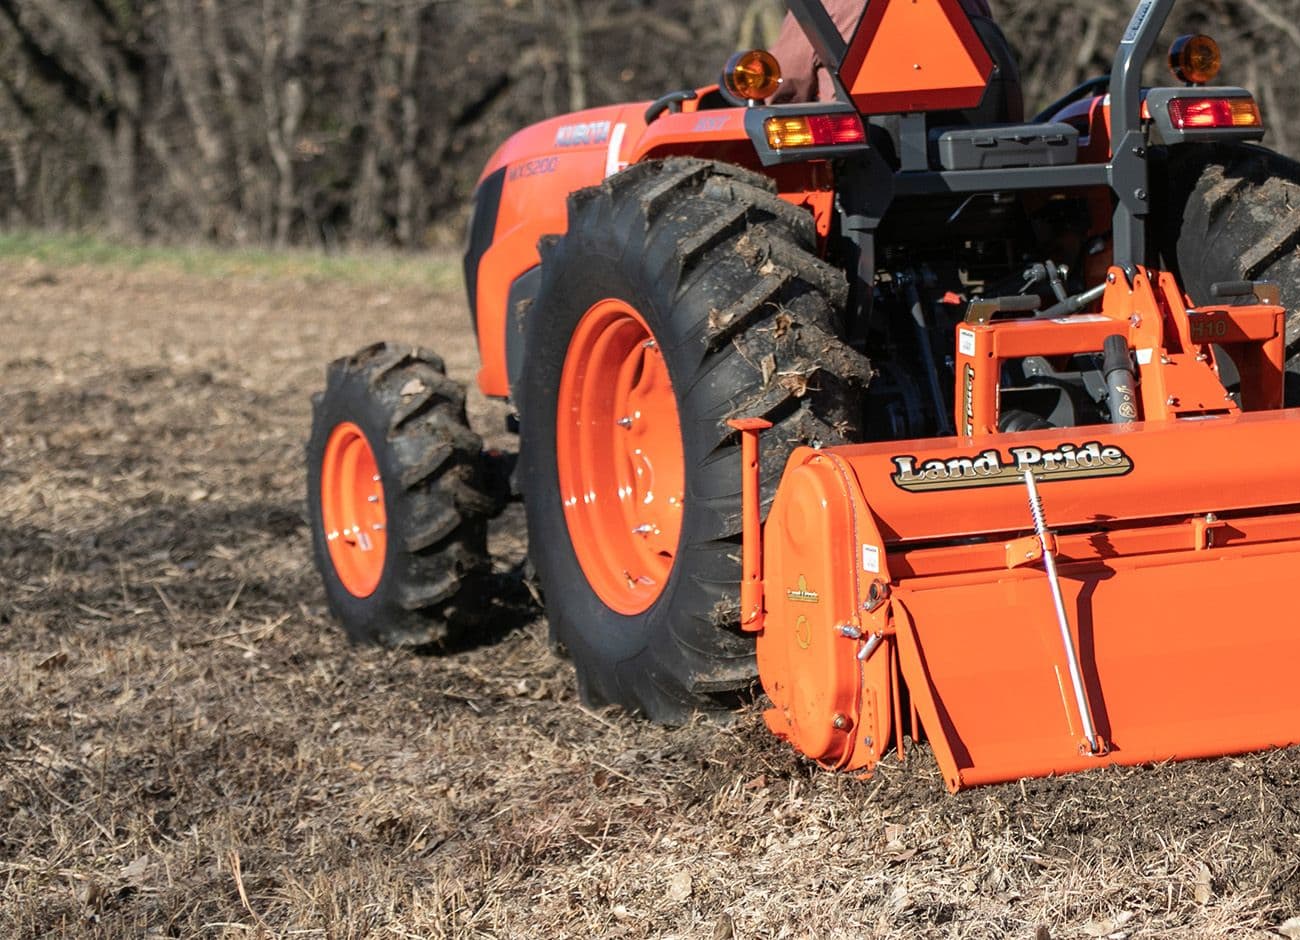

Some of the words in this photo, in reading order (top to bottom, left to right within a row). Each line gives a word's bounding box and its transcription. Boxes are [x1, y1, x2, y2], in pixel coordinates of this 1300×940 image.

[554, 121, 611, 148] KUBOTA
[893, 449, 1002, 482] Land
[1011, 442, 1124, 473] Pride
